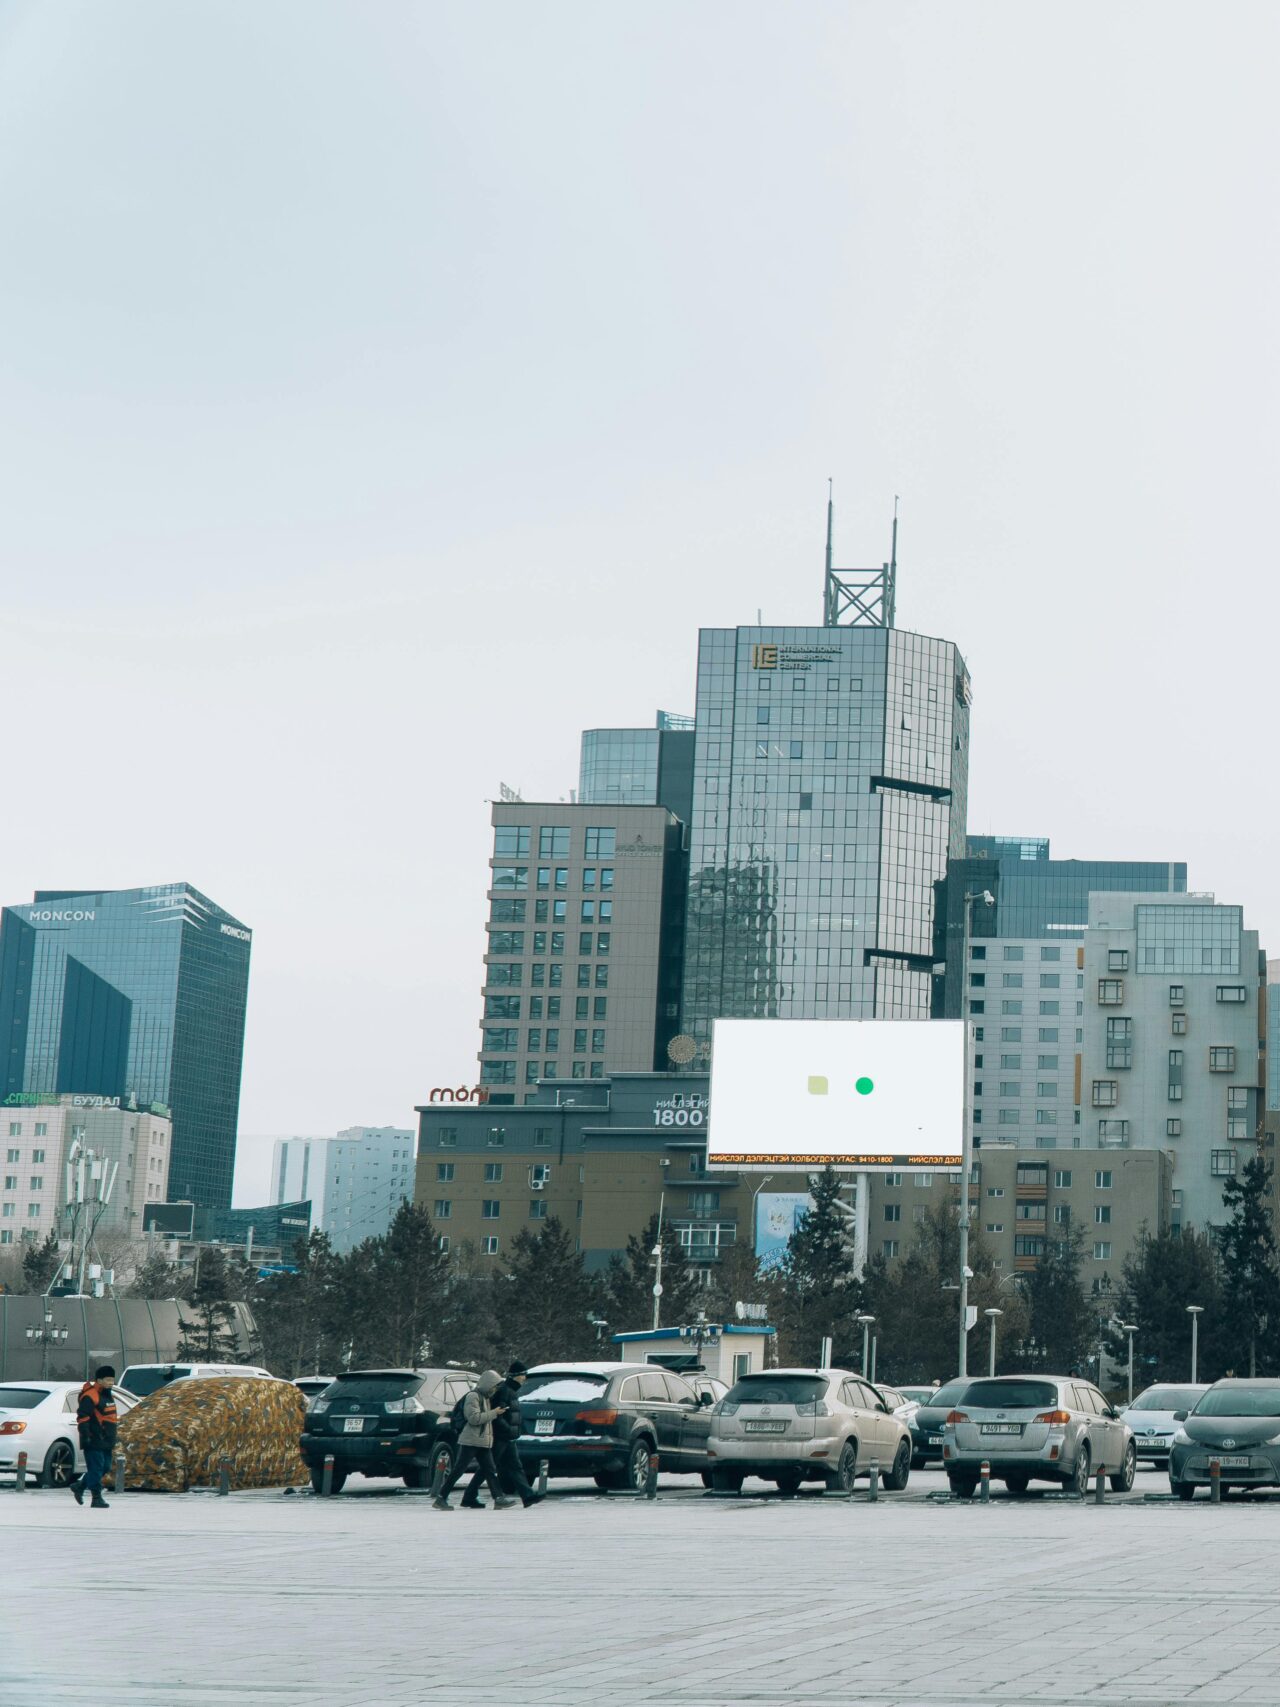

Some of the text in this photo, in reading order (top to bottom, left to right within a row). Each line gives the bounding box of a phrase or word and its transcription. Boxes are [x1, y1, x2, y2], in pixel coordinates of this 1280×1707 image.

[29, 910, 96, 921] MONCON
[220, 923, 251, 942] MONCON
[73, 1096, 120, 1106] БУУДАЛ
[710, 1154, 744, 1162] НИЙСЛЭЛ
